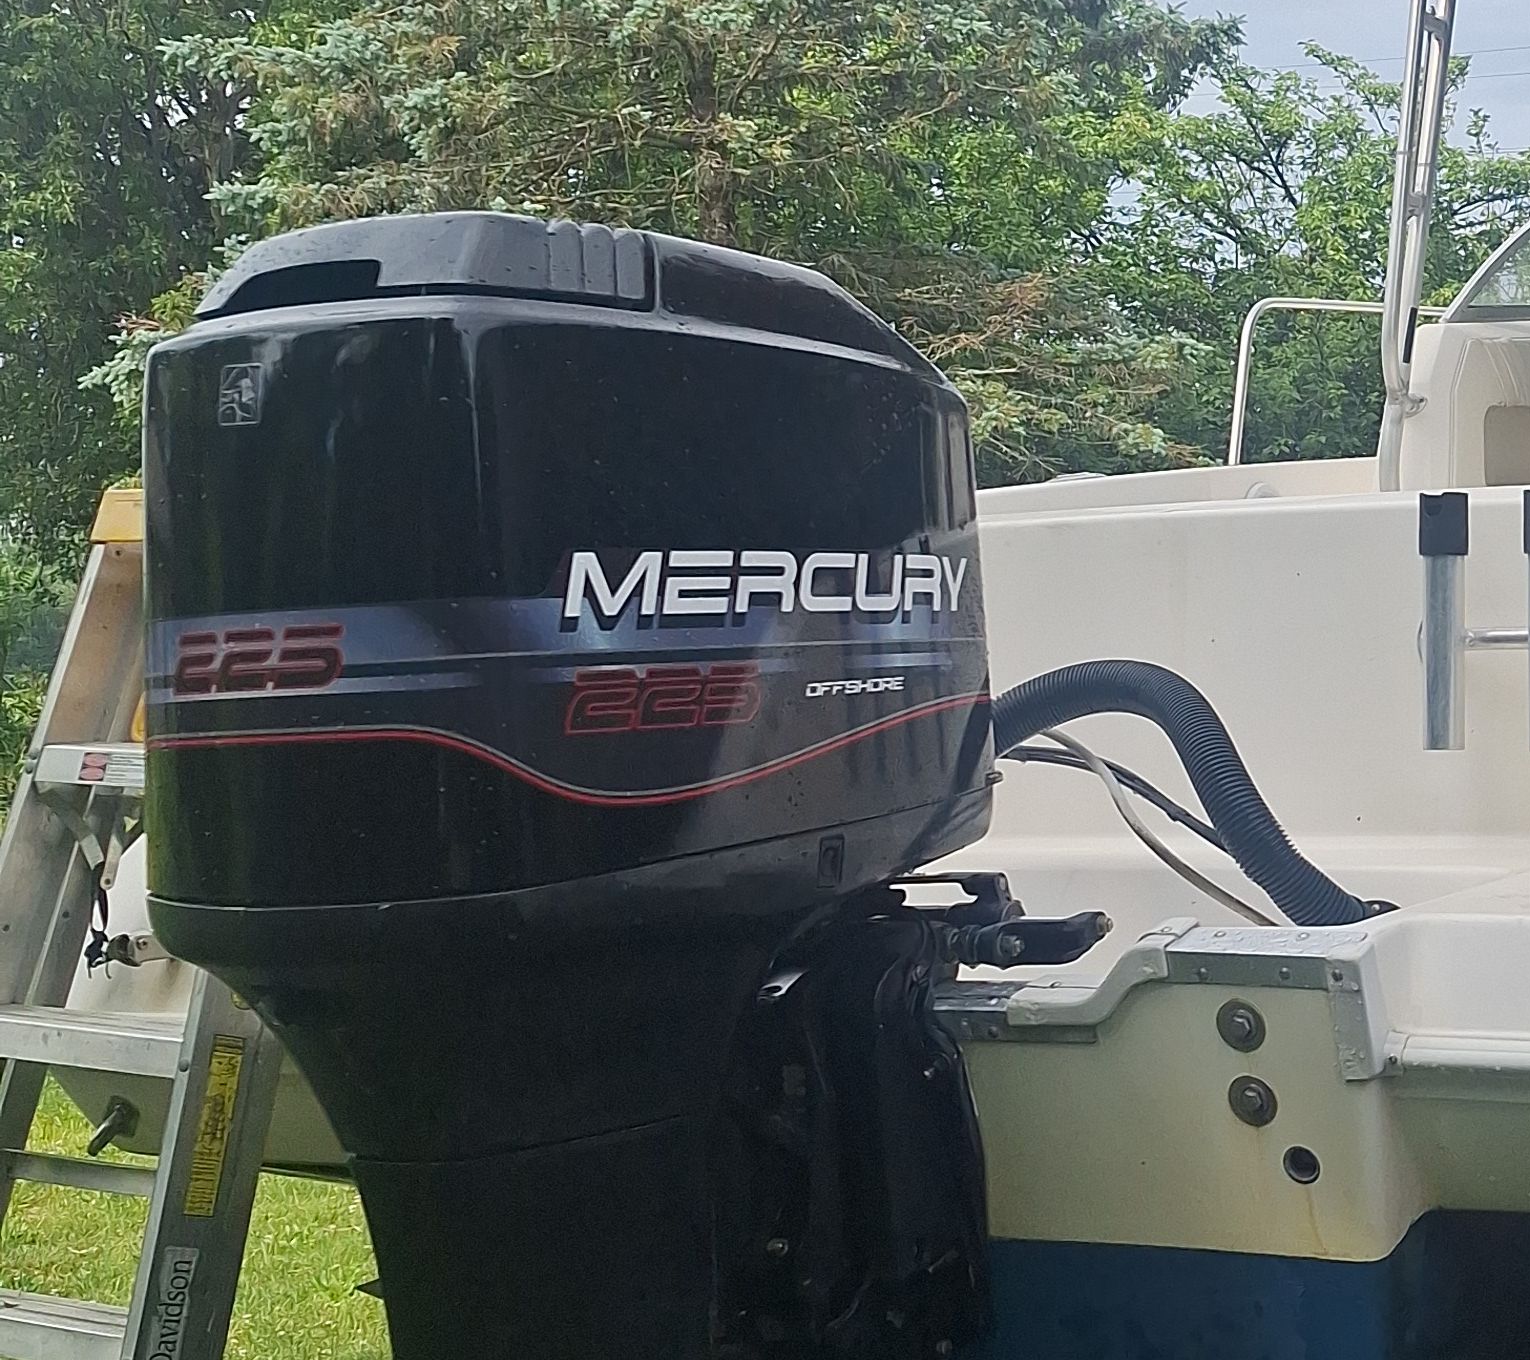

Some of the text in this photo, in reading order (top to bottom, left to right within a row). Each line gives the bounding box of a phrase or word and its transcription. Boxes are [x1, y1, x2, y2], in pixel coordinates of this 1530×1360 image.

[563, 549, 968, 619] MERCURY
[172, 622, 346, 697] 225
[804, 676, 906, 698] OFFSHORE
[563, 658, 763, 735] 225
